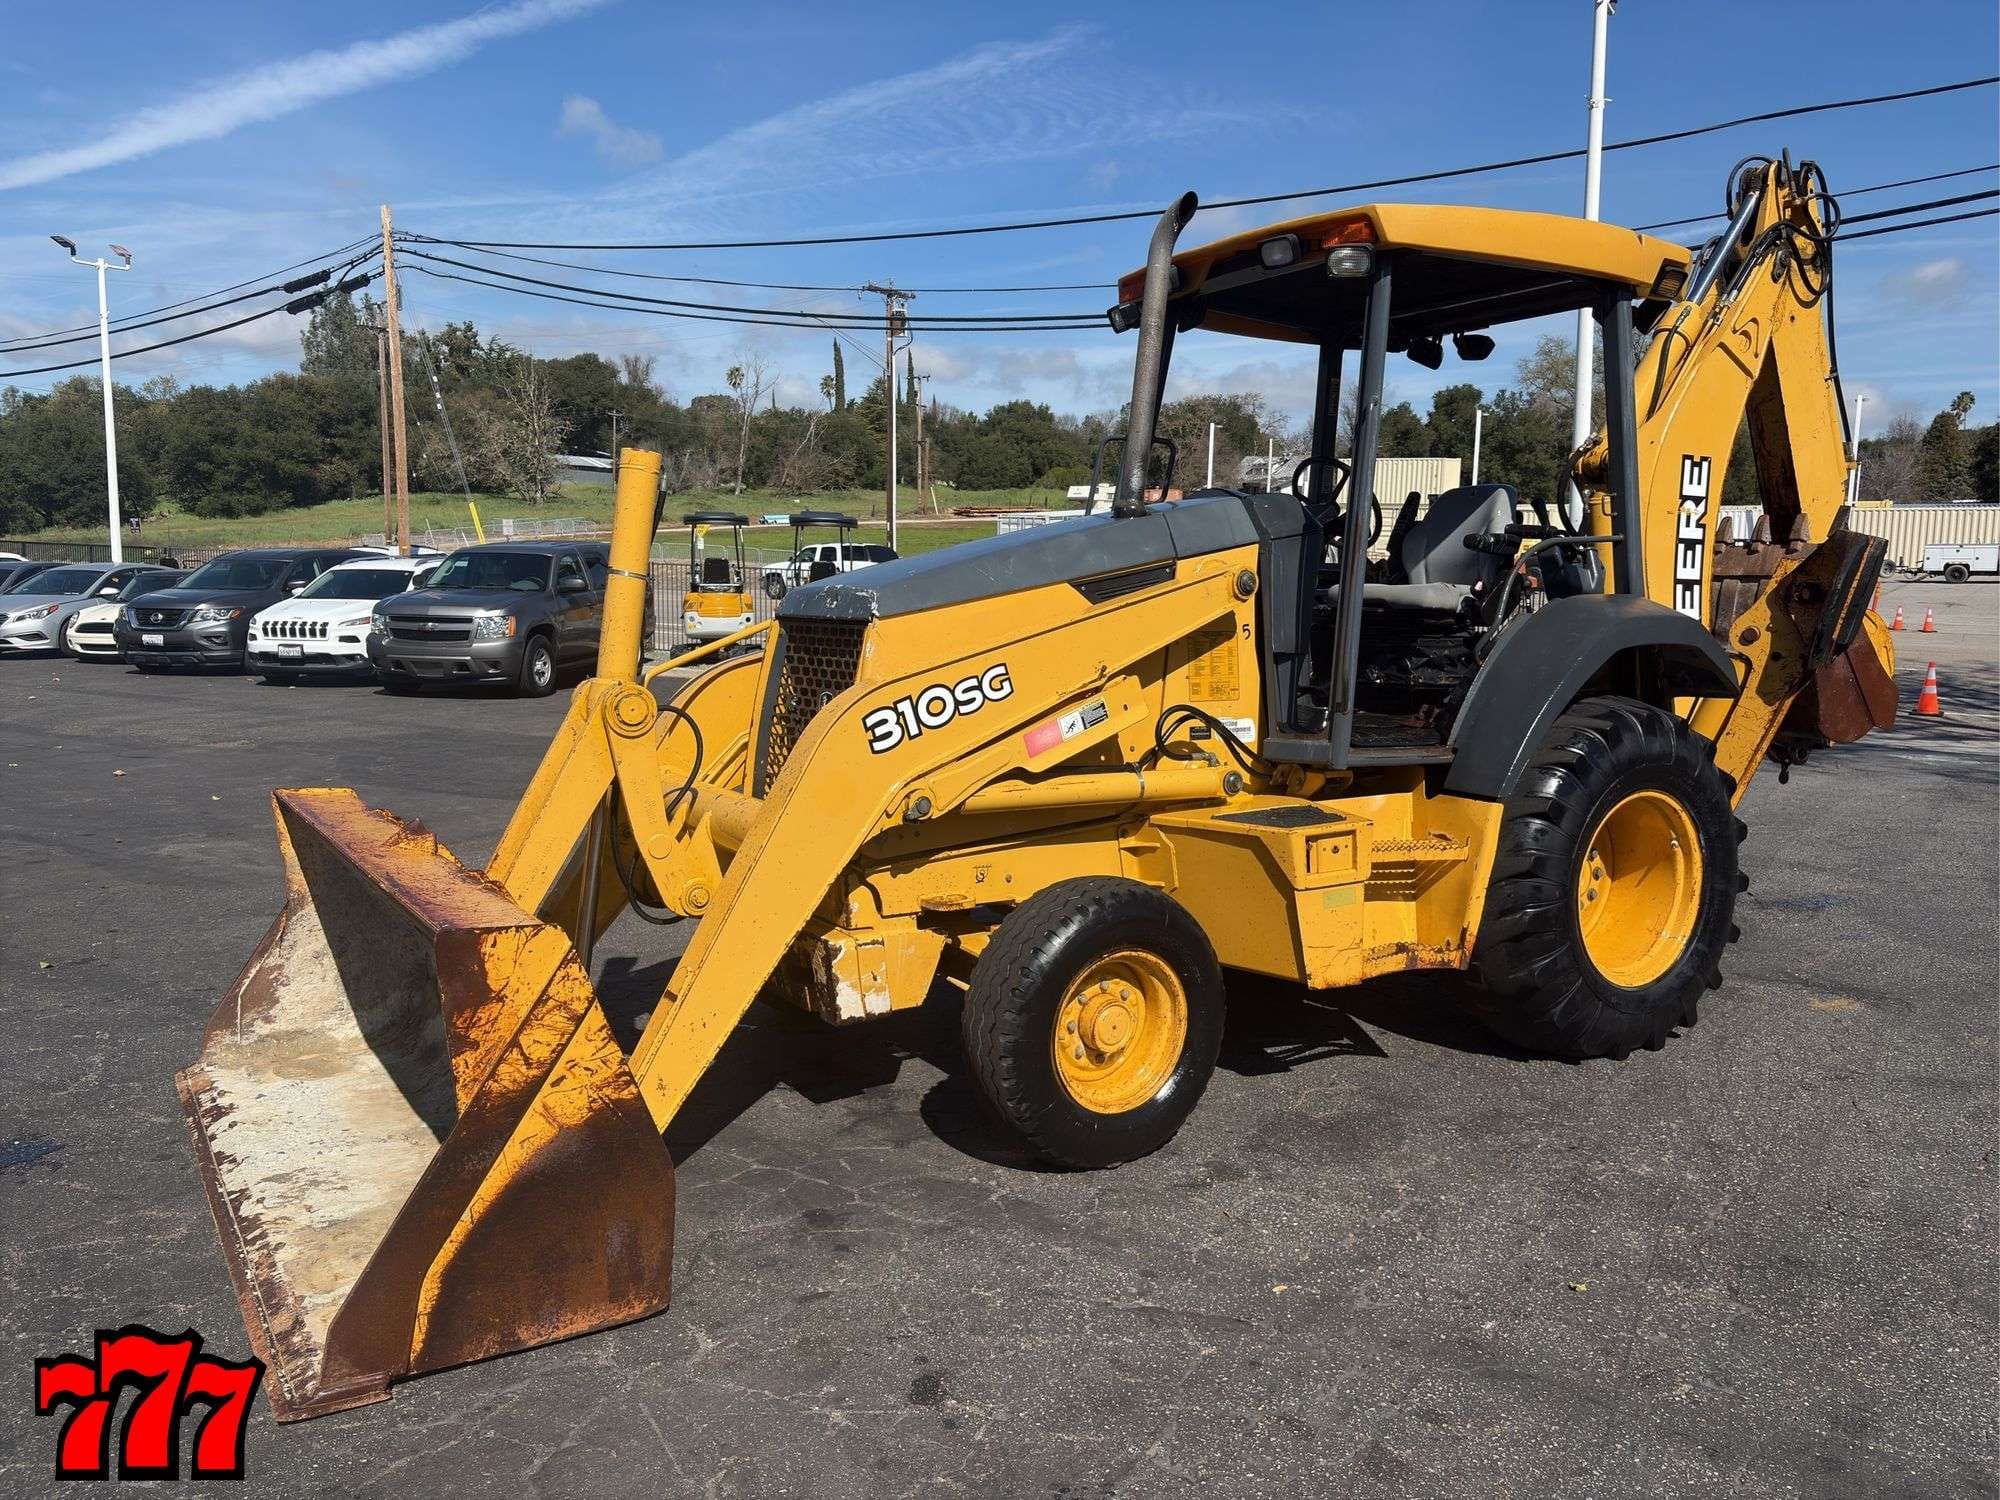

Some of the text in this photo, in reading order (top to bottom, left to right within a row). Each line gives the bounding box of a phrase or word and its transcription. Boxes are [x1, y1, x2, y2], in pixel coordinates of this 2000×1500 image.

[1674, 456, 1711, 622] EERE
[1242, 623, 1251, 640] 5
[863, 664, 1013, 753] 310SG
